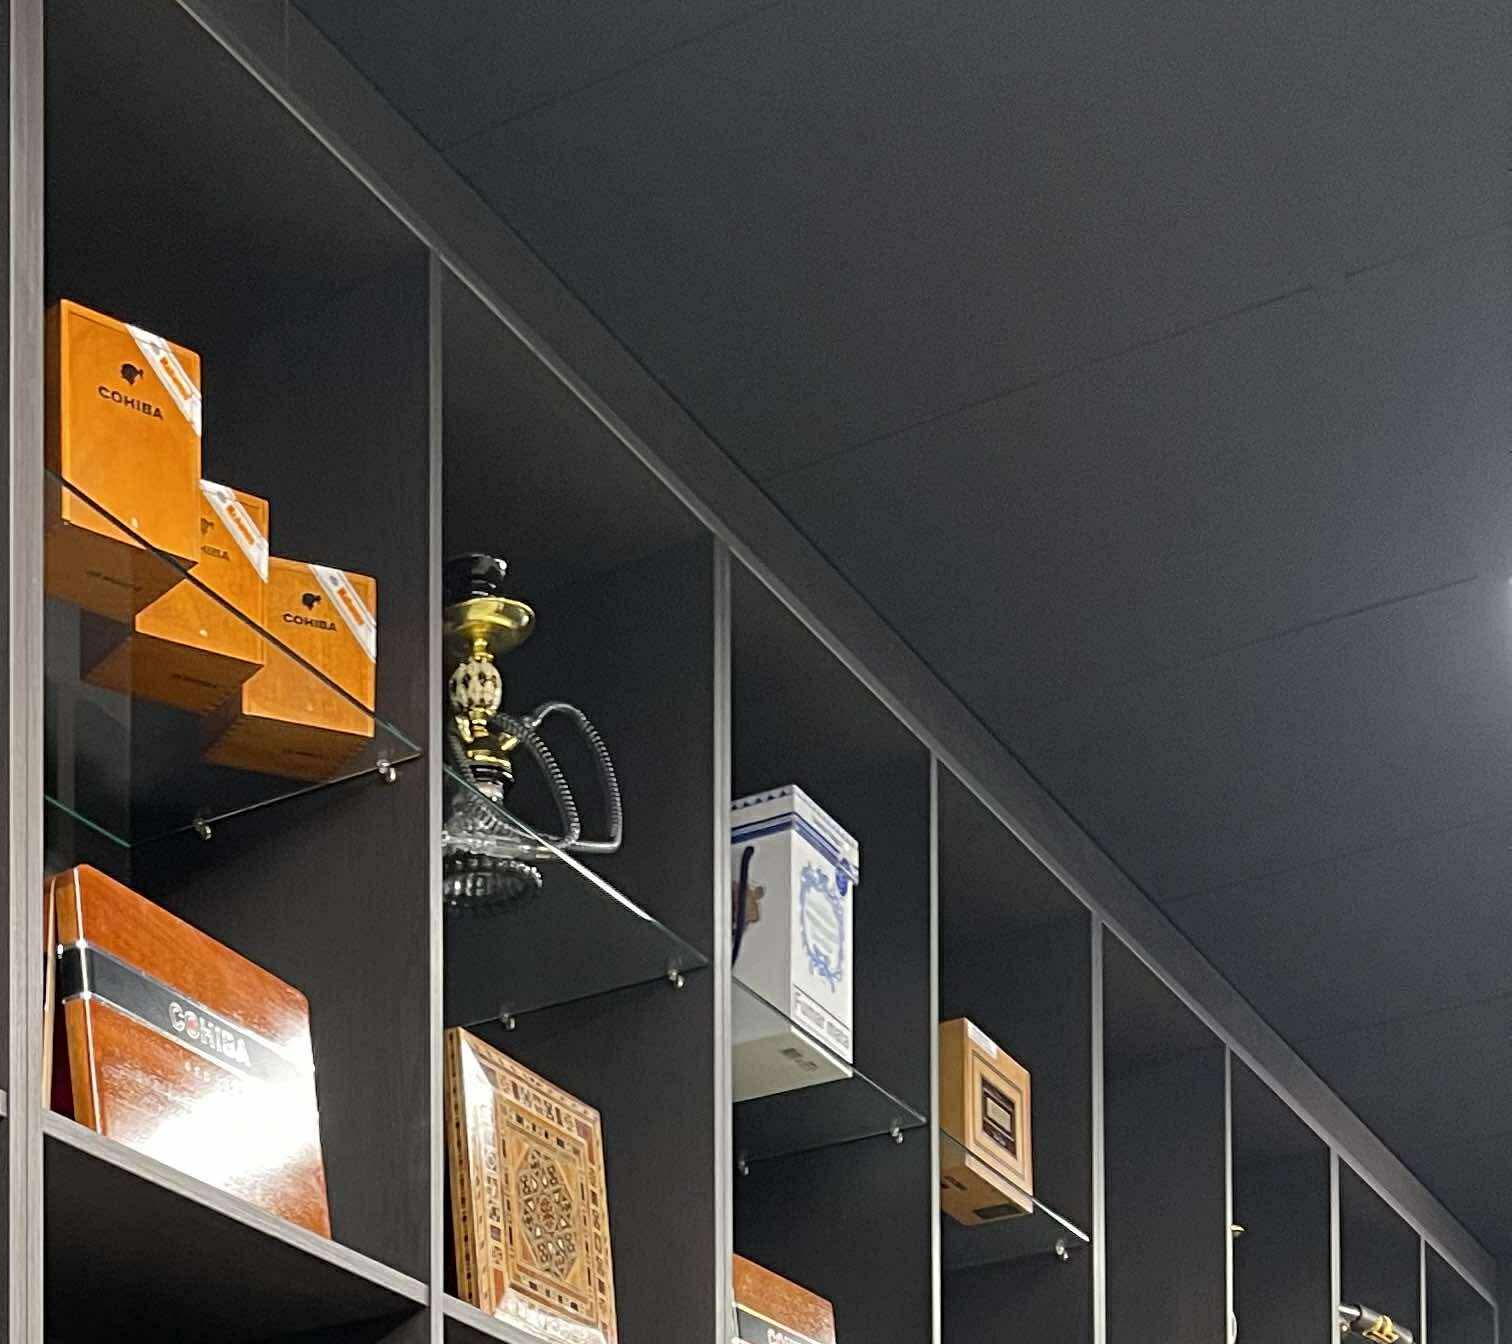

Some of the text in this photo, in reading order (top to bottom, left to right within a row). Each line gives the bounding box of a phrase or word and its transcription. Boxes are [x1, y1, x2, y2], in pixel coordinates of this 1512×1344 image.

[98, 385, 164, 421] COHIBA
[282, 612, 337, 632] COHIBA
[168, 1001, 251, 1068] COHIBA
